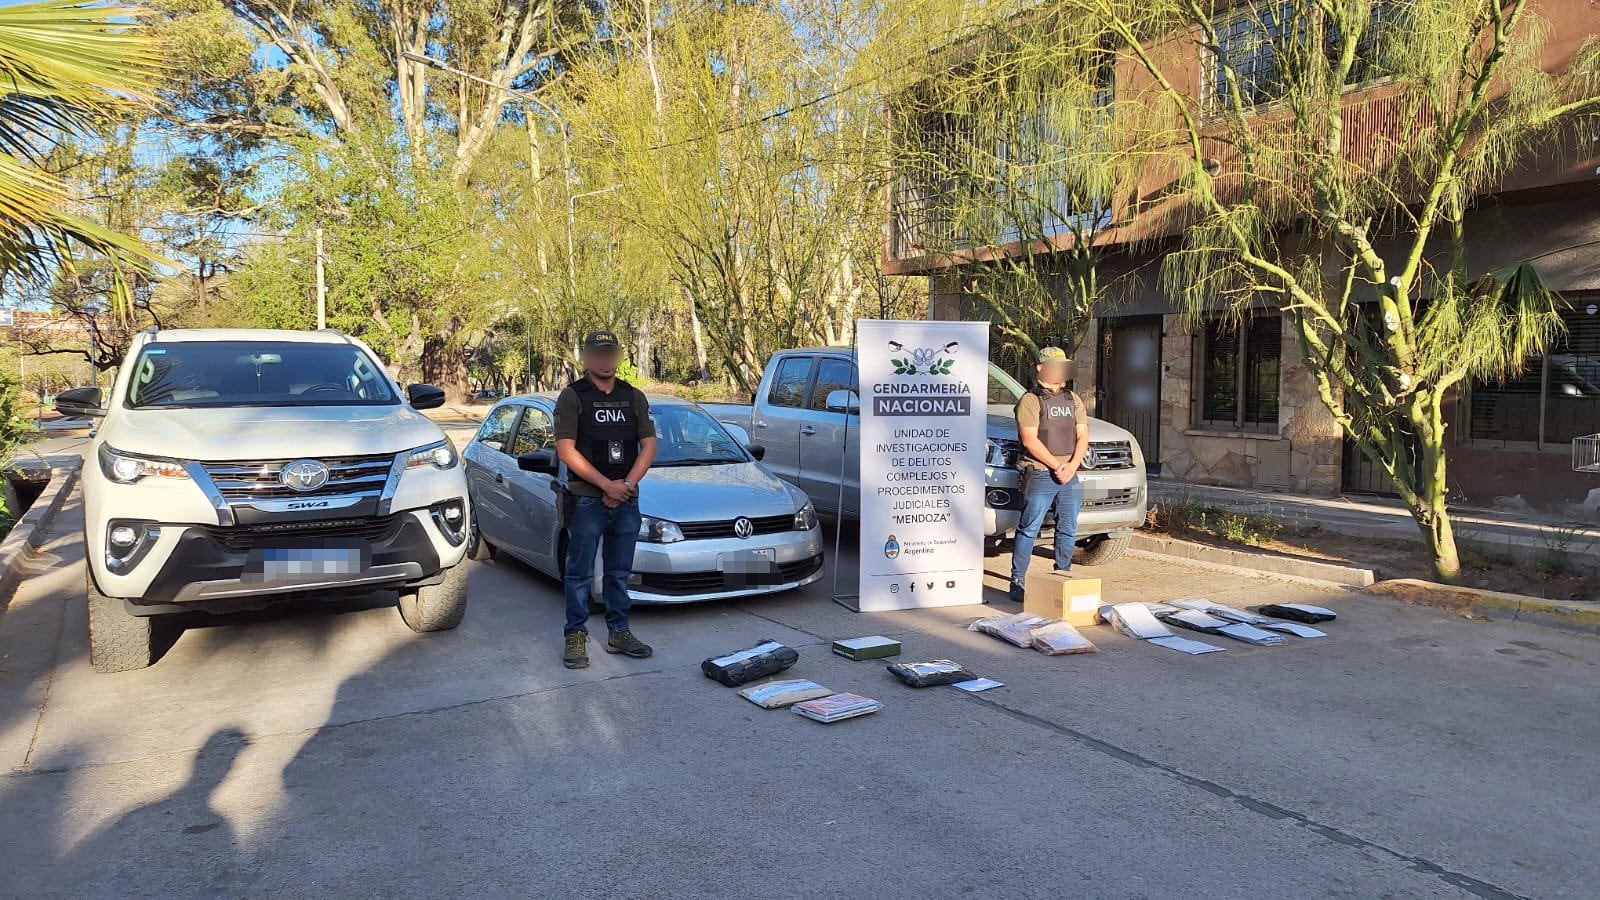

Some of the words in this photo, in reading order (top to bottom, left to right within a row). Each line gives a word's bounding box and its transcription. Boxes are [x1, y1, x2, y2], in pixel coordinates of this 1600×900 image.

[873, 381, 971, 394] GENDARMERÍA
[879, 399, 966, 413] NACIONAL
[1050, 406, 1072, 417] GNA
[595, 409, 626, 422] GNA
[894, 429, 934, 438] UNIDAD
[935, 429, 950, 438] DE
[876, 443, 968, 453] INVESTIGACIONES
[891, 458, 905, 467] DE
[908, 457, 952, 467] DELITOS
[886, 471, 948, 481] COMPLEJOS
[950, 471, 958, 480] Y
[877, 484, 966, 496] PROCEDIMENTOS
[287, 501, 329, 510] SW4
[893, 499, 950, 510] JUDICIALES
[892, 513, 951, 524] "MENDOZA"
[904, 547, 935, 556] Argentina
